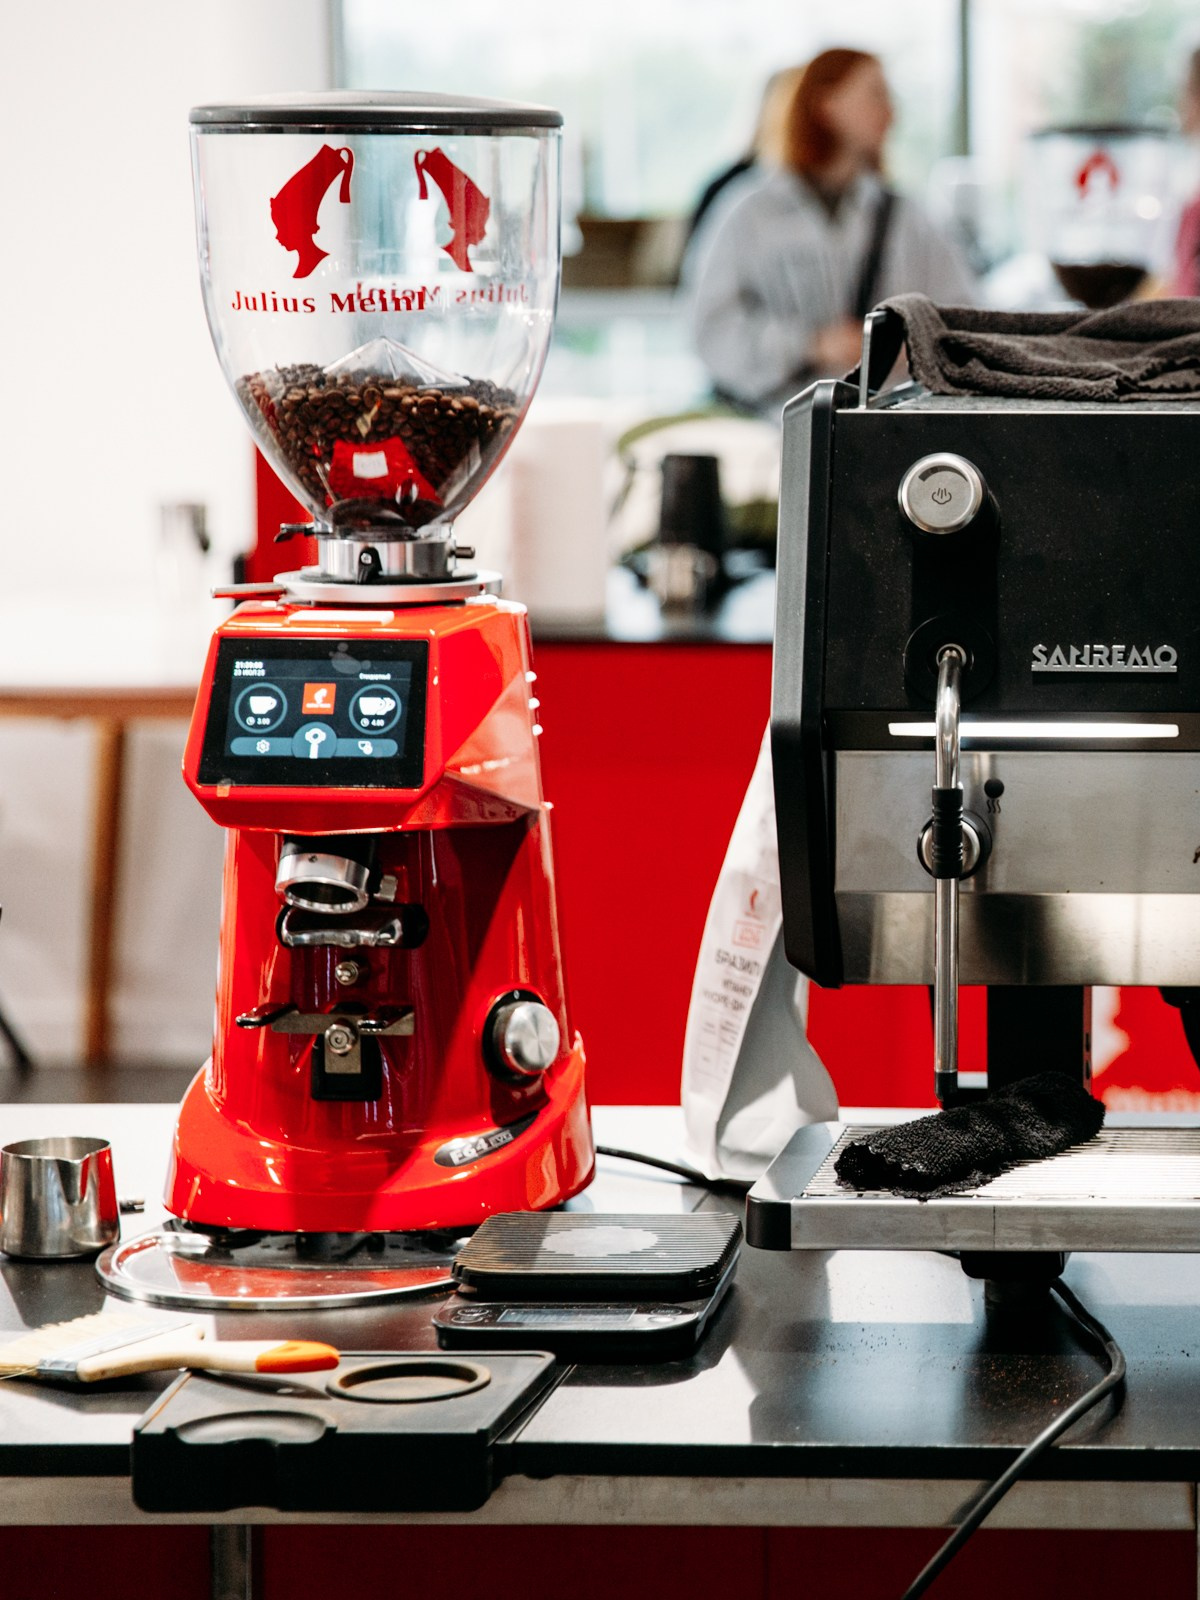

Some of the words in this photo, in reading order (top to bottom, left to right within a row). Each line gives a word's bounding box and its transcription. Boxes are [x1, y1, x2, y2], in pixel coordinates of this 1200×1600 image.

[231, 289, 316, 313] Julius
[329, 290, 425, 313] Meinl
[1031, 644, 1178, 672] SANREMO
